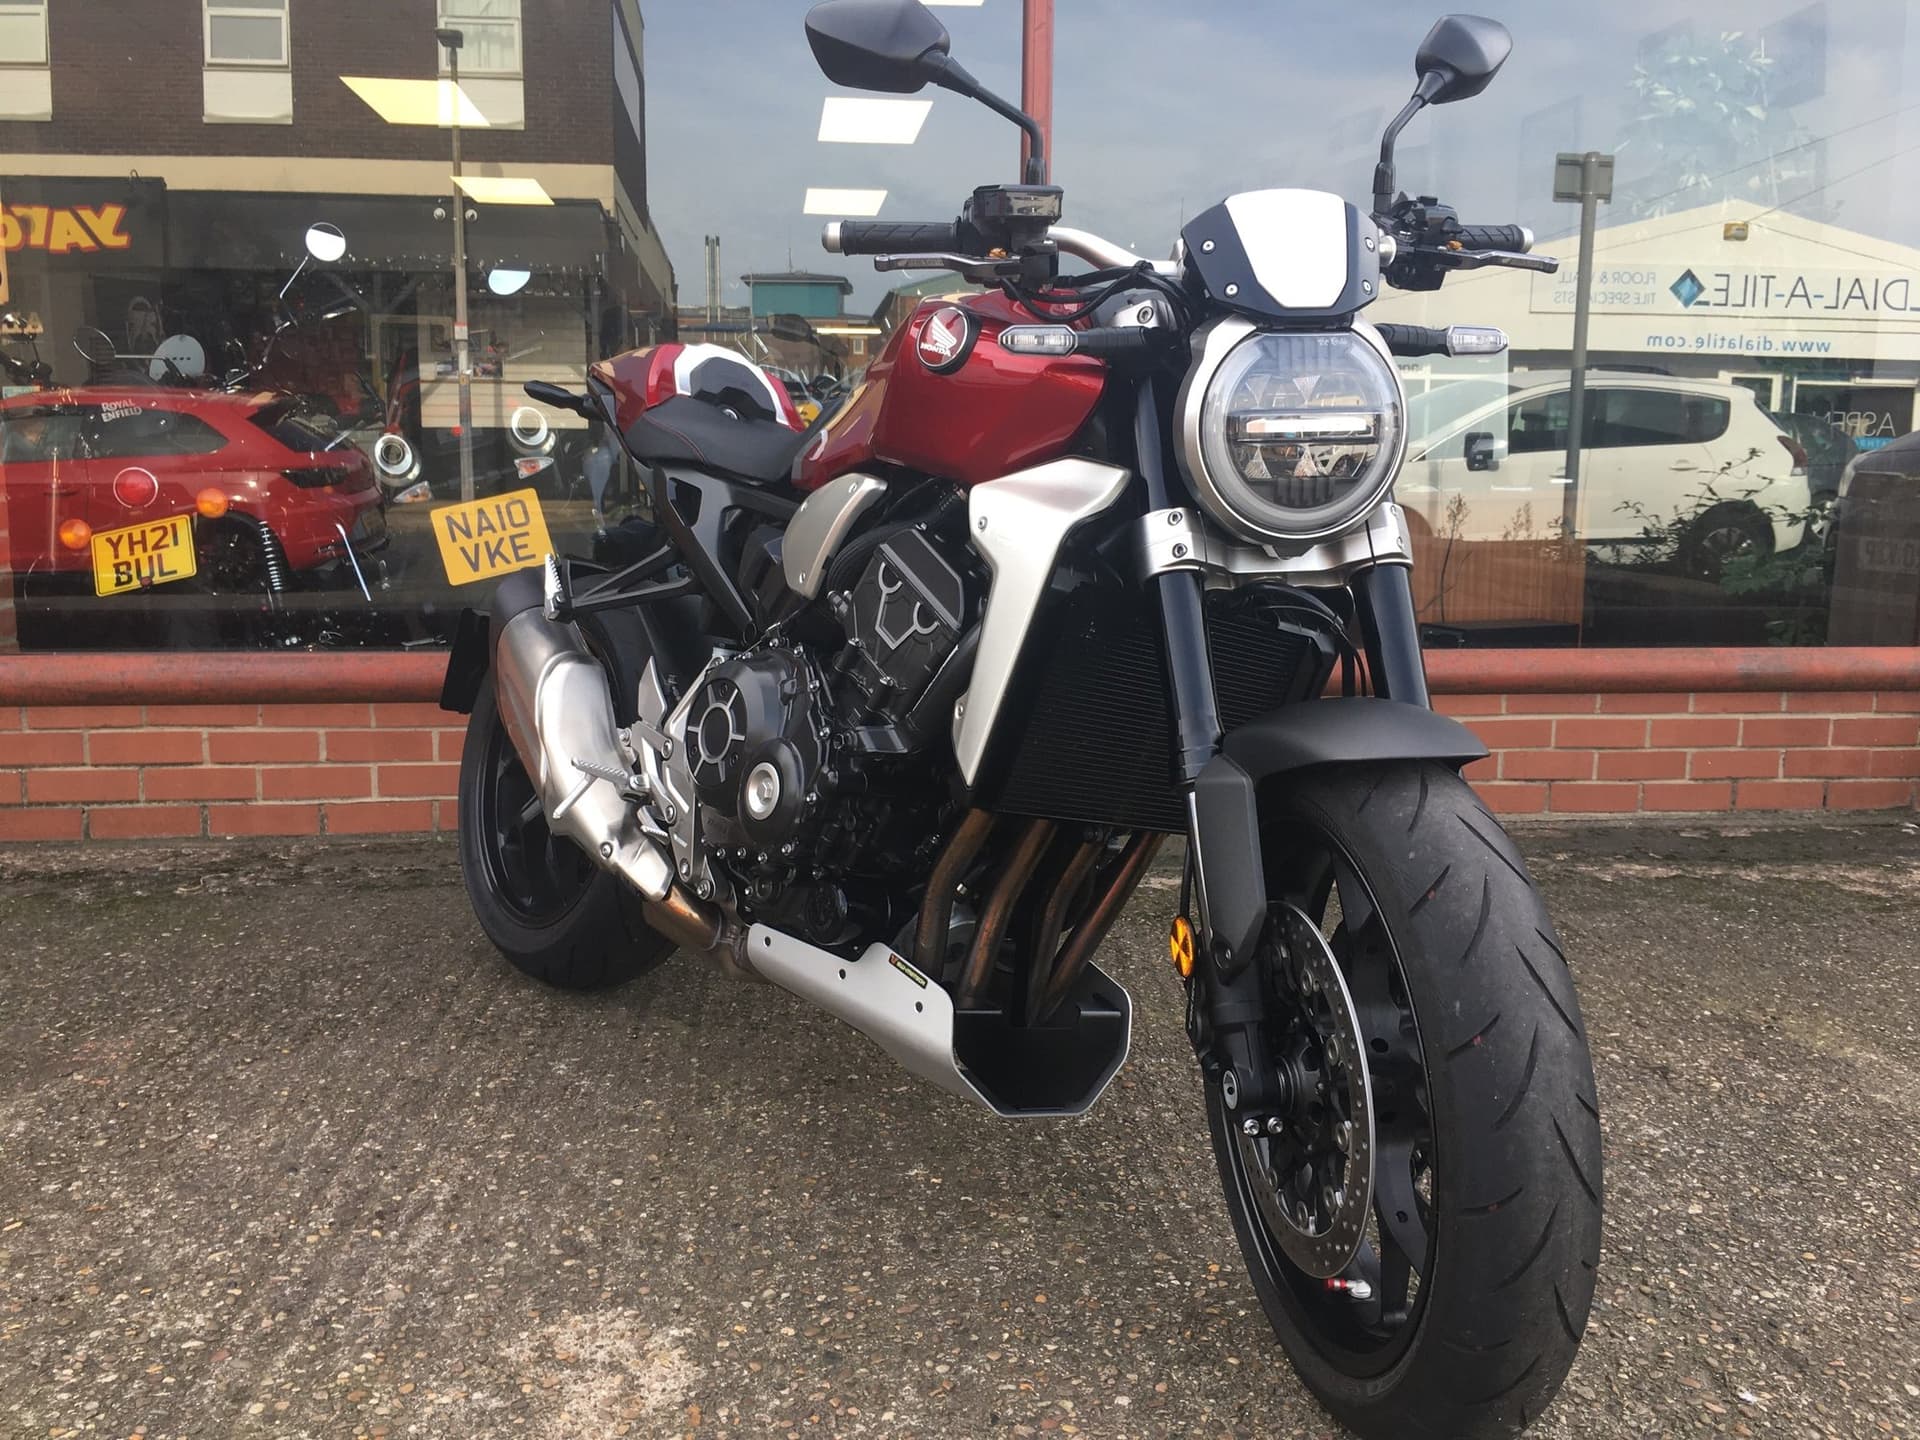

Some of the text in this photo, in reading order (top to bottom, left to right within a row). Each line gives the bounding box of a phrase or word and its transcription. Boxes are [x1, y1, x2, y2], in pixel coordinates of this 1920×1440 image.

[920, 342, 952, 357] HONDA
[101, 398, 136, 412] ROYAL
[101, 406, 143, 422] ENFIELD
[445, 498, 530, 544] NA10
[105, 522, 179, 560] YH21
[459, 531, 537, 573] VKE
[112, 552, 178, 588] BUL
